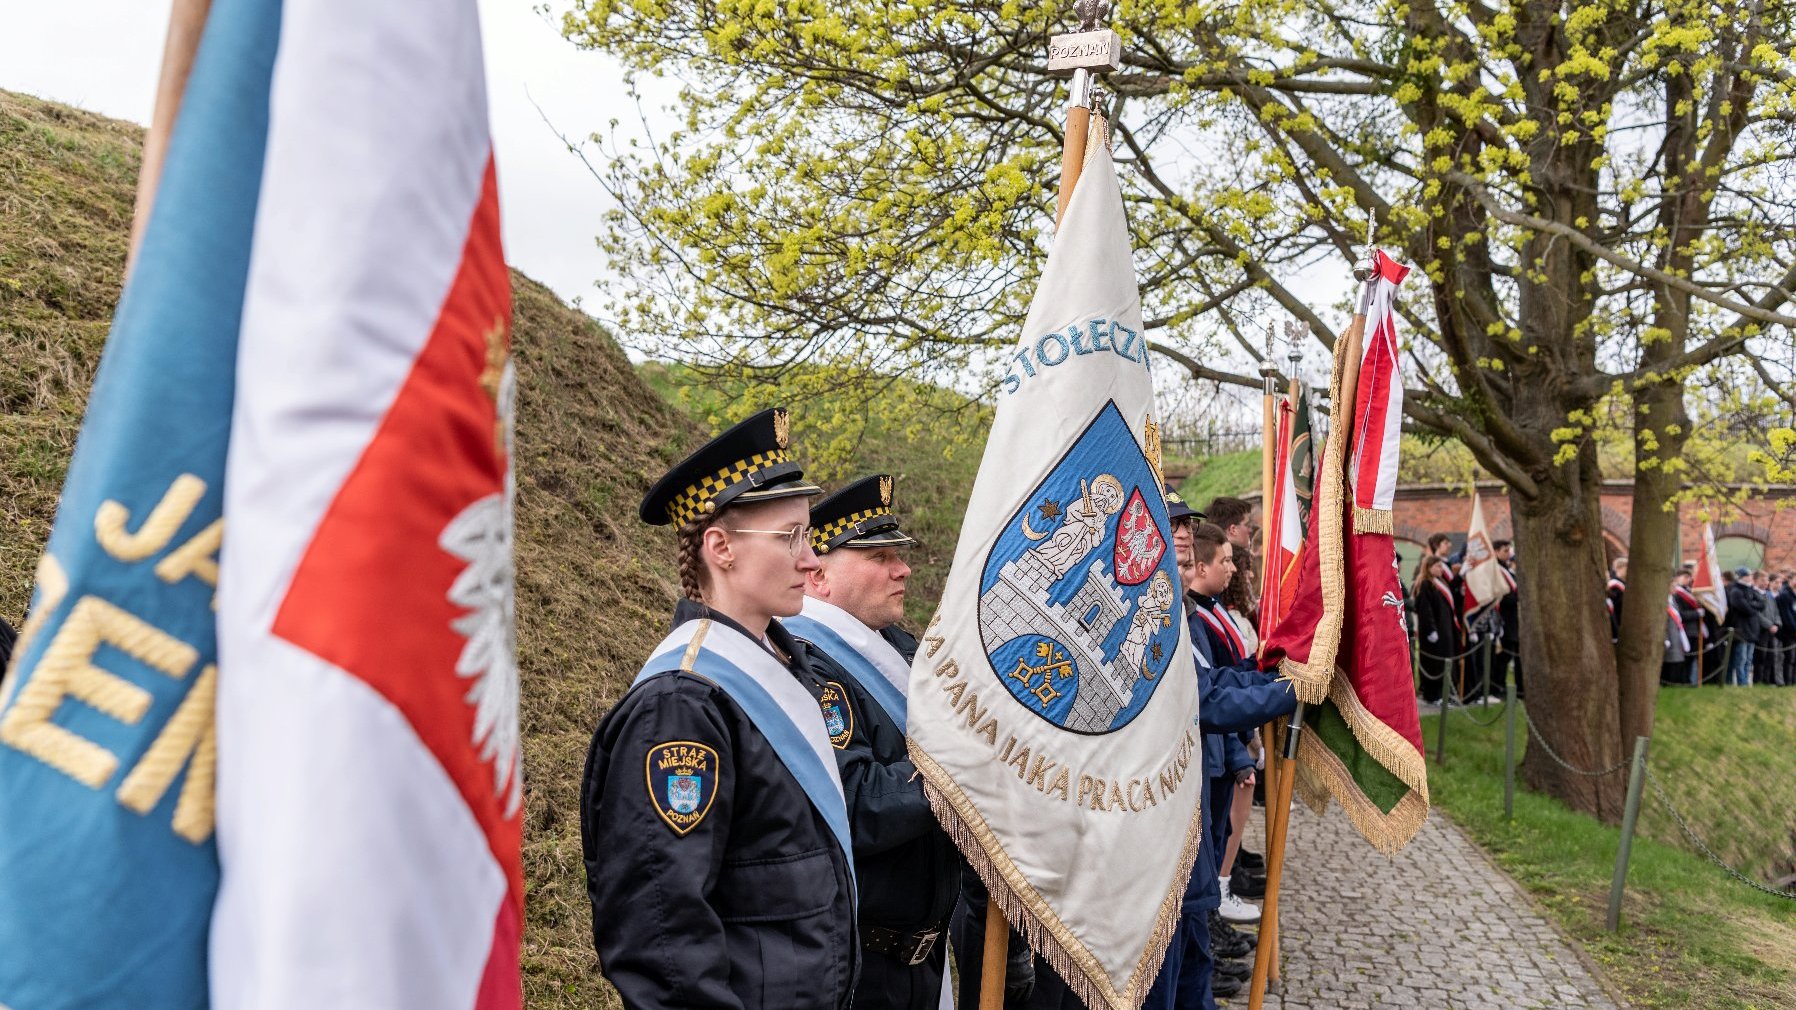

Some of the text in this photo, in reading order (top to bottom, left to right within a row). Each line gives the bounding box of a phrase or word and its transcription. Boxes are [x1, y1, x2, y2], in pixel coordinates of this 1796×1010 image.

[935, 657, 999, 746] PANA
[1077, 773, 1158, 812] PRACA
[1159, 729, 1195, 801] NASZA
[658, 756, 707, 772] MIEJSKA
[665, 808, 701, 824] POZNAŃ
